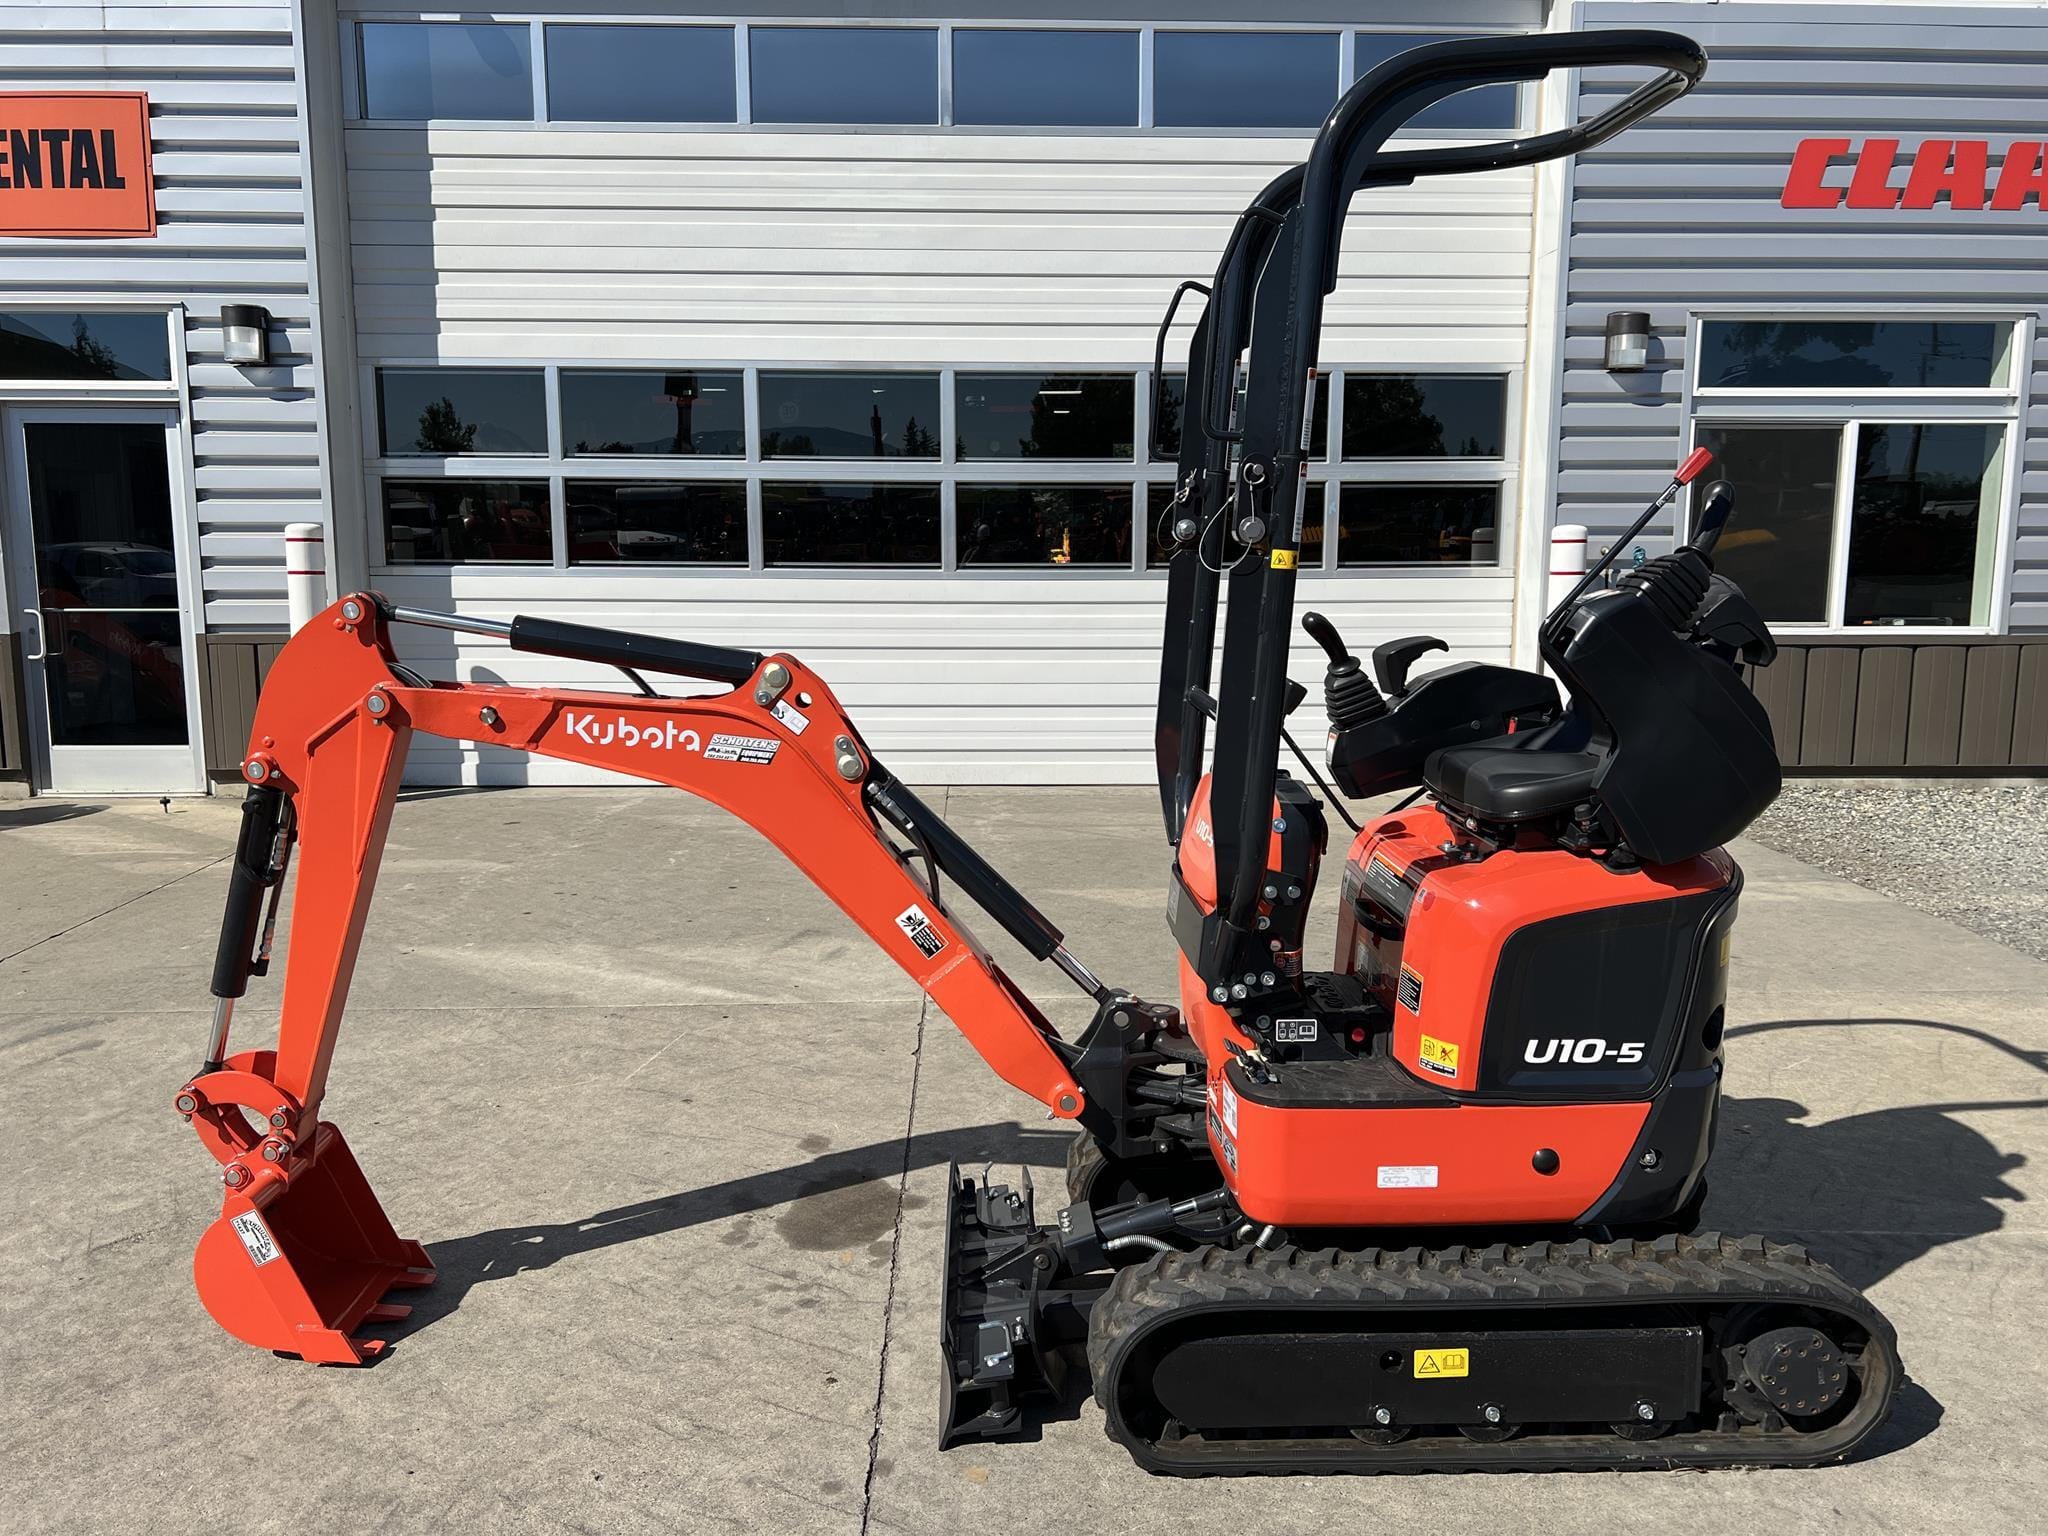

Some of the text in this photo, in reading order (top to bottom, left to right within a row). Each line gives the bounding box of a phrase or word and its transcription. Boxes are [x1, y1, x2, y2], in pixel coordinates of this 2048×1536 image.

[567, 713, 700, 751] Kubota
[712, 735, 778, 750] SCHOLTEN'S
[1524, 1038, 1645, 1063] U10-5
